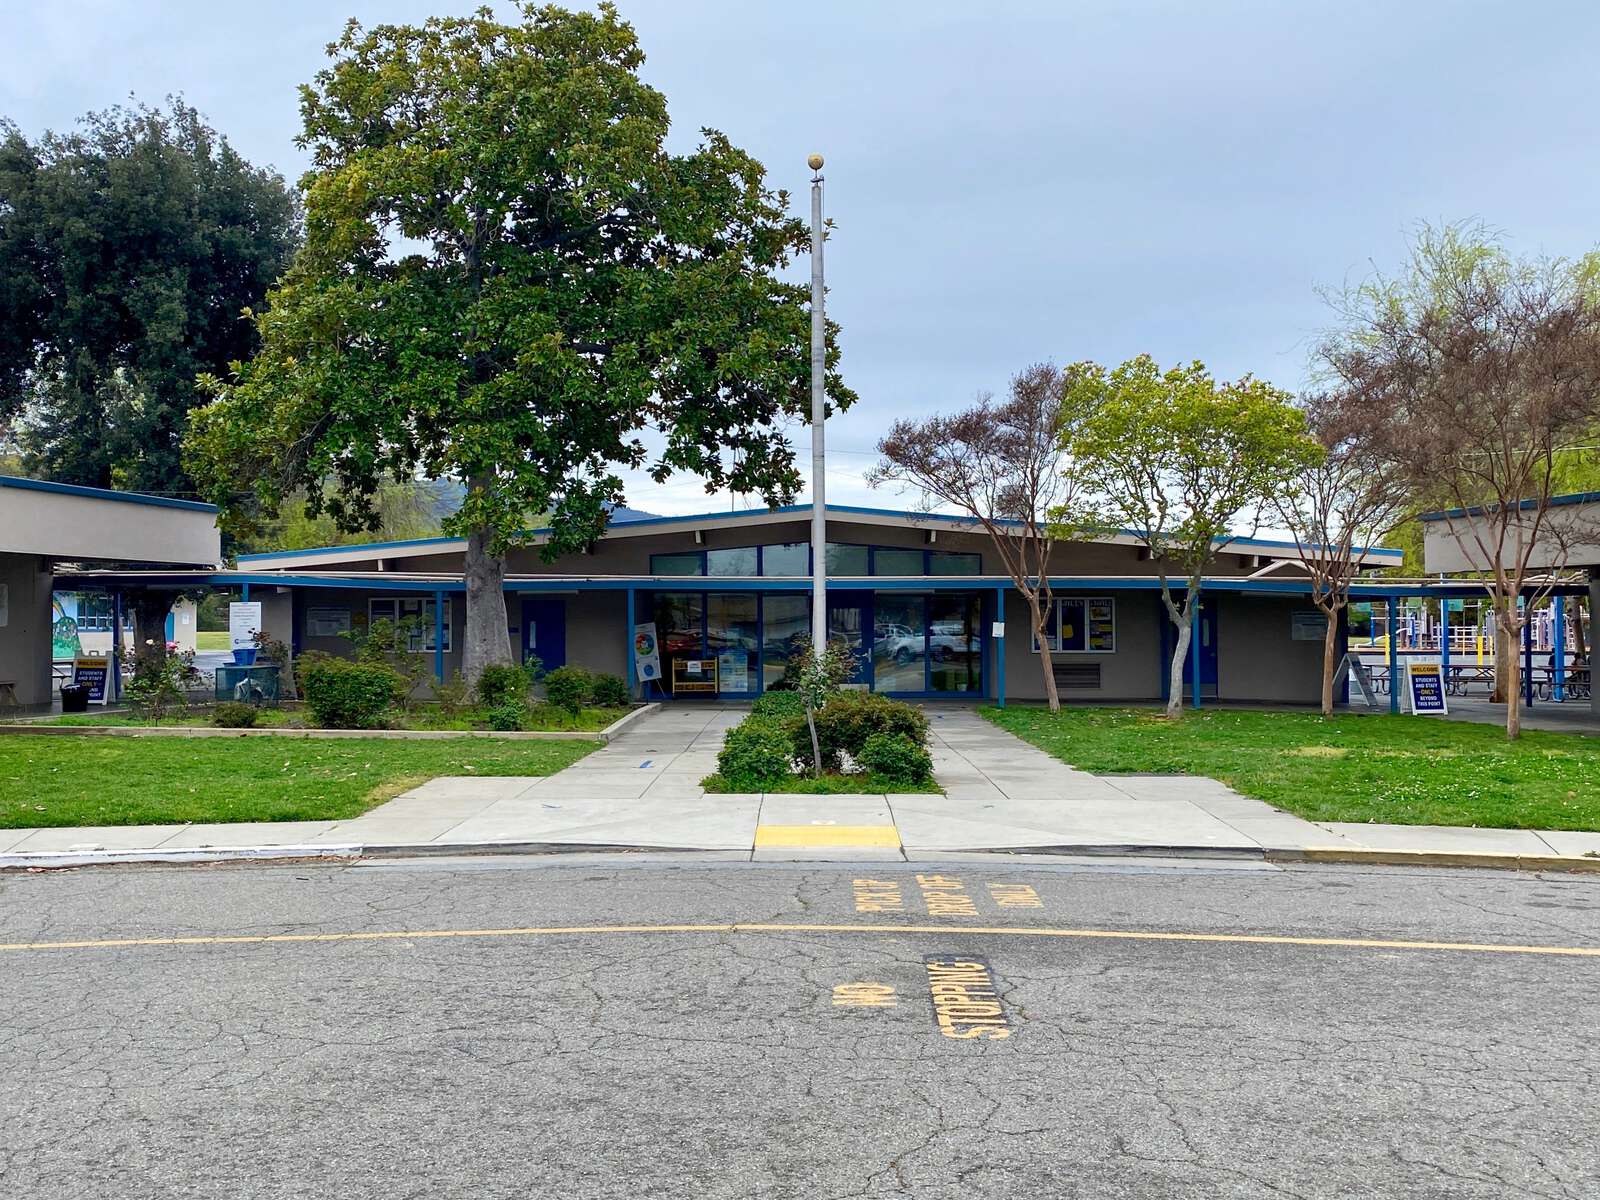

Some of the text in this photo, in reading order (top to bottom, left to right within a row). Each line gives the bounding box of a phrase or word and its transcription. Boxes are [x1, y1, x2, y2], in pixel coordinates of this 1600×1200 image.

[923, 892, 980, 915] DROP
[832, 983, 897, 1006] NO
[926, 962, 1010, 1039] STOPPING
